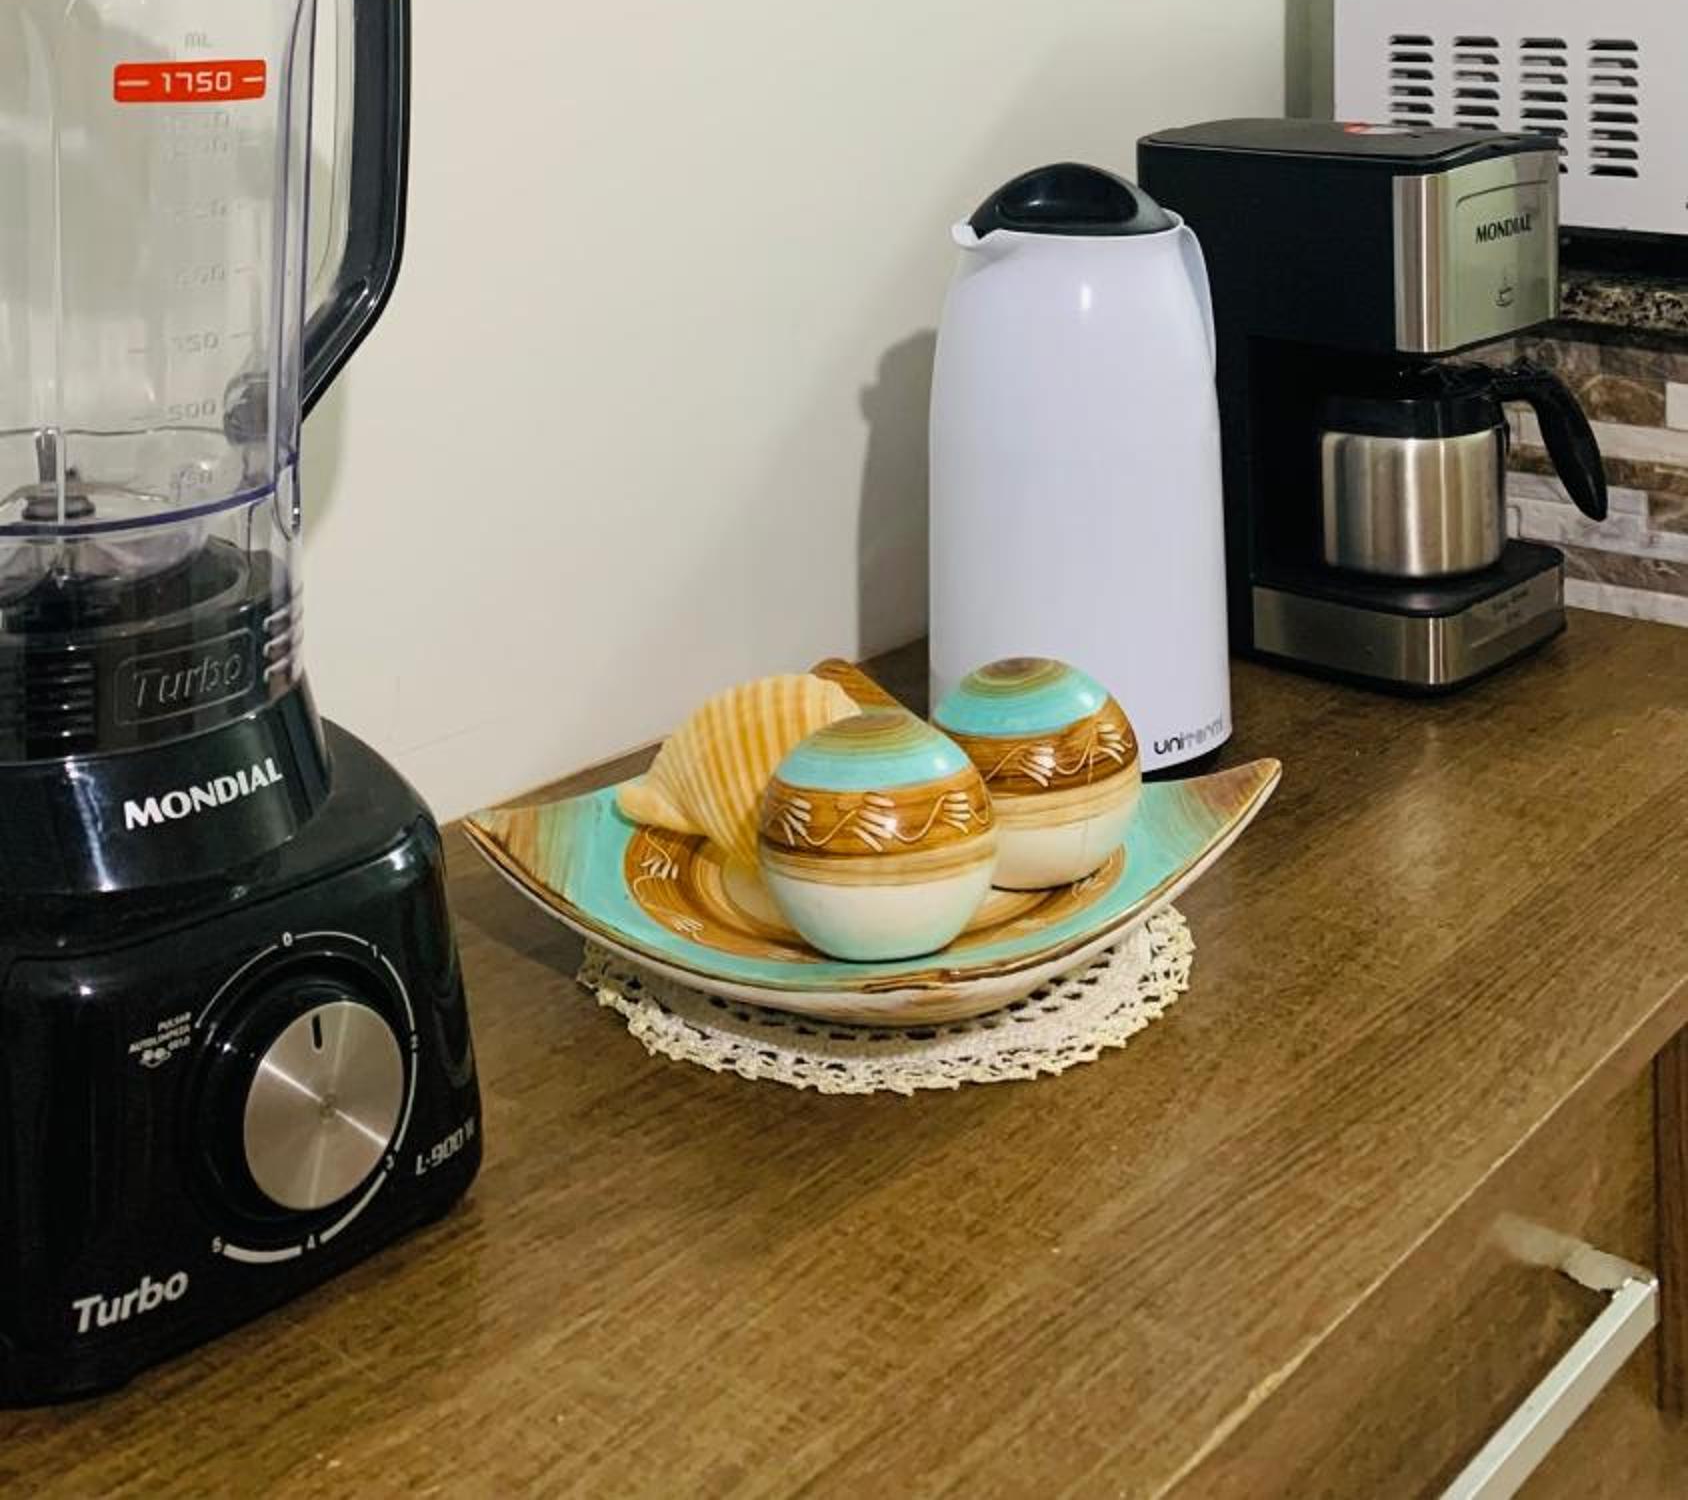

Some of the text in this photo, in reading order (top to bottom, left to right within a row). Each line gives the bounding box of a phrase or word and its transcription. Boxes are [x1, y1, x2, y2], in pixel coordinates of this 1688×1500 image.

[161, 71, 233, 94] 1750
[1475, 213, 1533, 244] MONDIAL
[133, 653, 242, 709] Turbo
[123, 757, 285, 831] MONDIAL
[282, 931, 294, 947] 0
[306, 1234, 316, 1250] 4
[72, 1270, 190, 1334] Turbo
